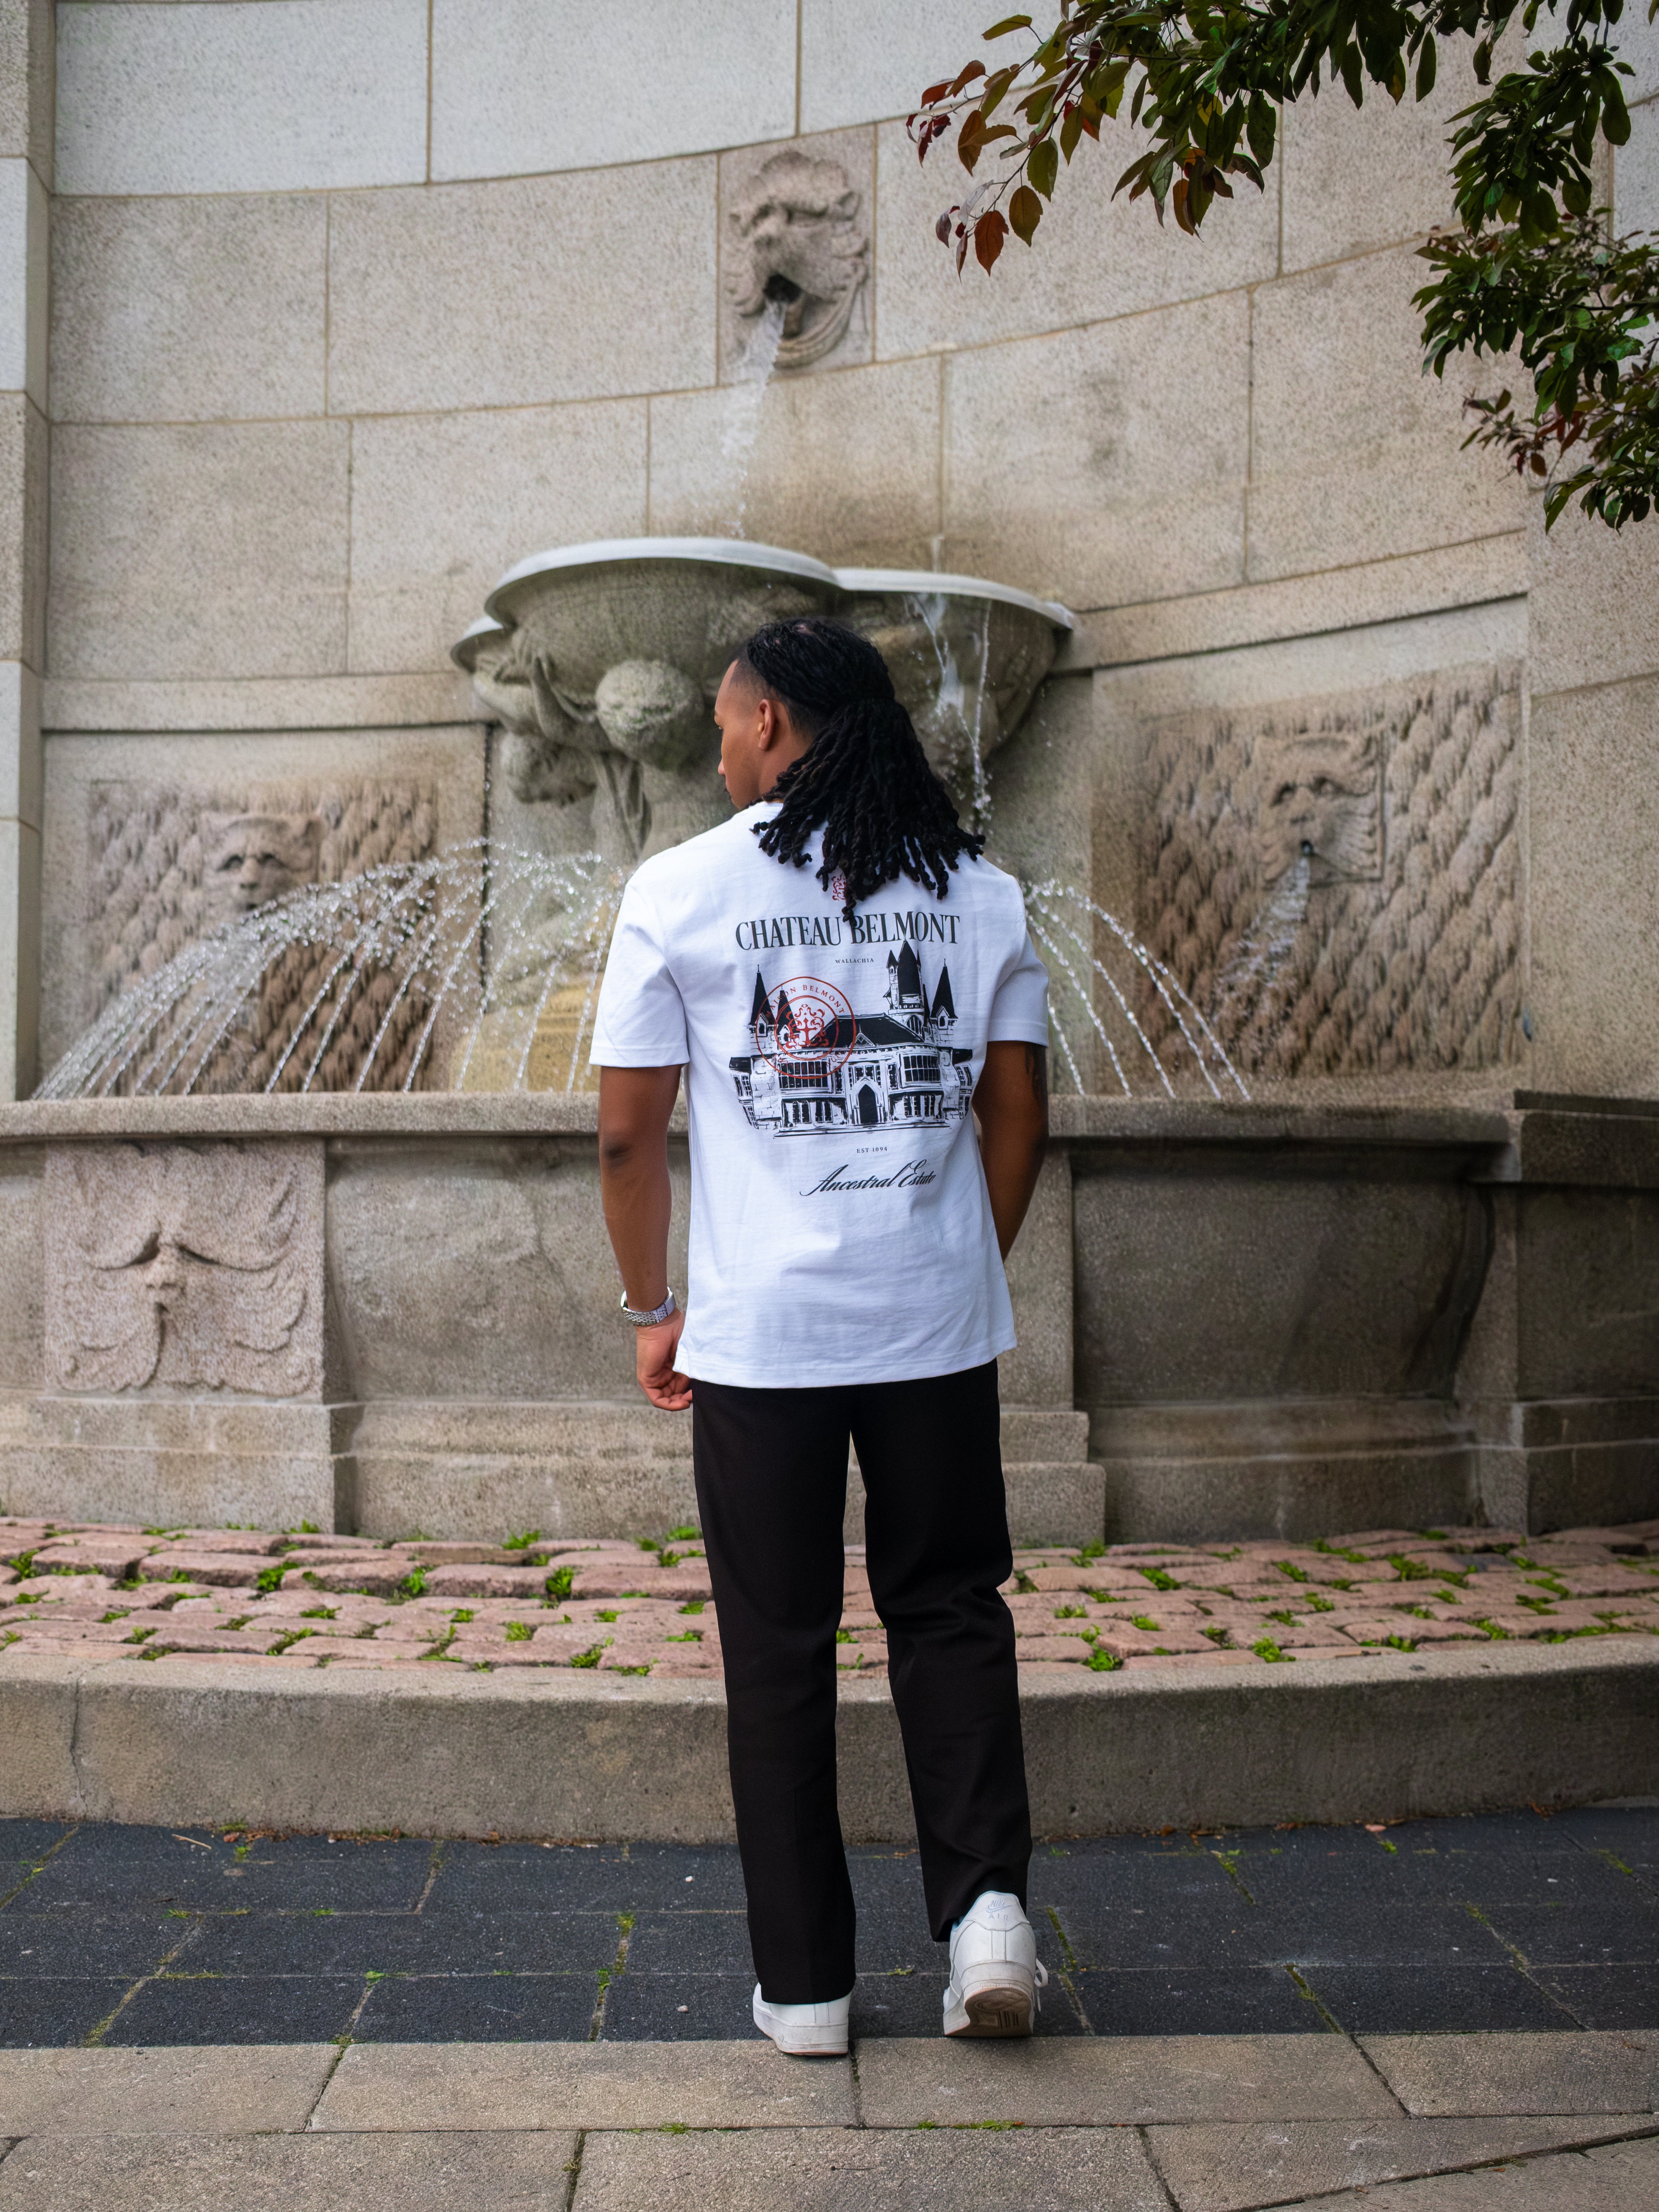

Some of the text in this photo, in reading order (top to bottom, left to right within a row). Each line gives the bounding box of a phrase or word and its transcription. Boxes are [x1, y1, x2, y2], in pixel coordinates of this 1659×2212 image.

[736, 911, 960, 950] CHATEAU BELMONT
[803, 985, 845, 1013] BELMONT
[799, 1159, 936, 1196] Ancestral Estate
